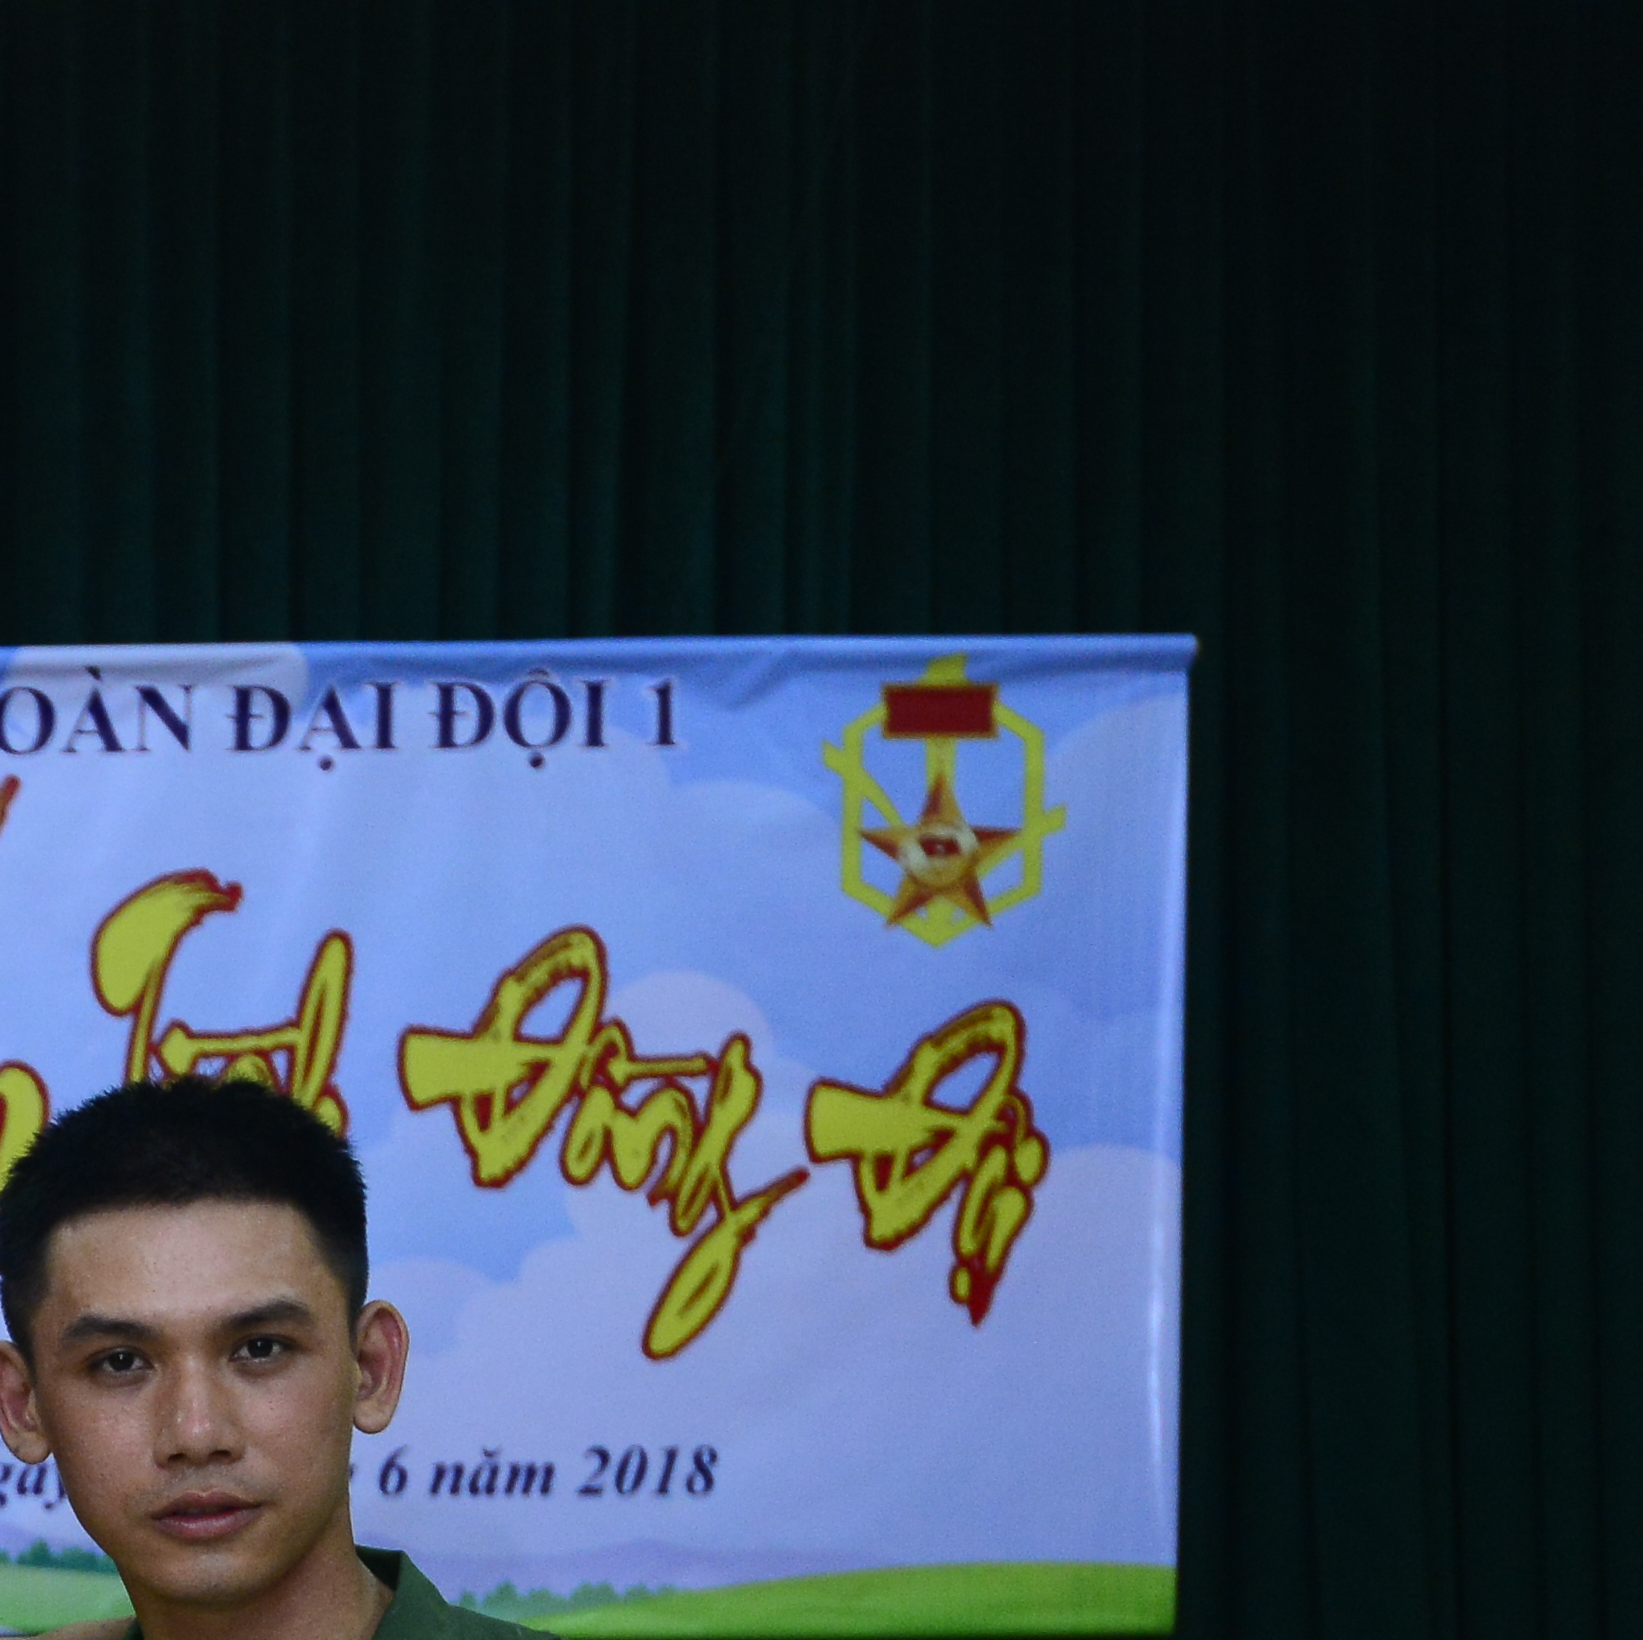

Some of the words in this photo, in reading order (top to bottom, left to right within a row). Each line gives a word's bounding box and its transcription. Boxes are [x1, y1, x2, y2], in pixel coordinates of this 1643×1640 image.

[226, 681, 399, 772] ĐẠI
[429, 668, 611, 770] ĐỘI
[649, 677, 679, 749] 1
[379, 1445, 409, 1497] 6
[429, 1445, 556, 1497] năm
[576, 1444, 719, 1497] 2018
